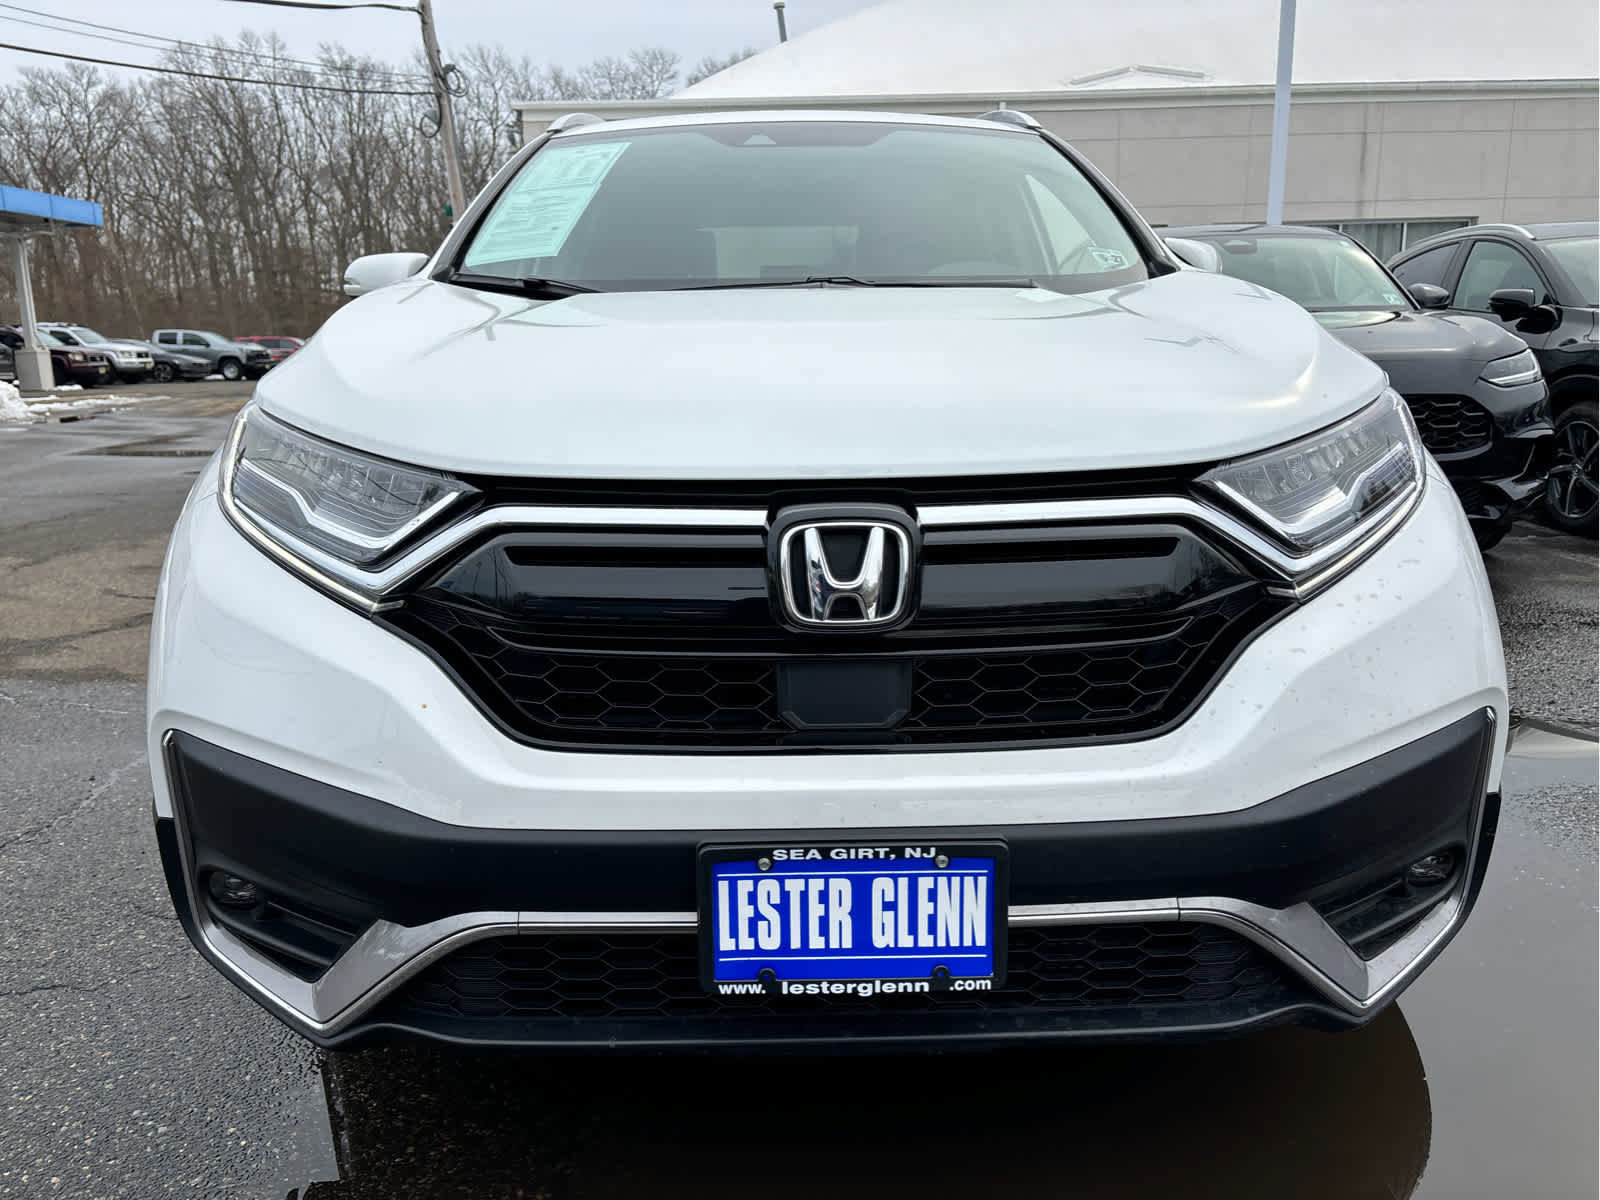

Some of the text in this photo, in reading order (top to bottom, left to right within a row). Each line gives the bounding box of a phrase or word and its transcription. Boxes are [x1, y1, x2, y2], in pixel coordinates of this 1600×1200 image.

[772, 847, 937, 861] SEA GIRT, NJ
[717, 876, 988, 952] LESTER GLENN
[718, 977, 992, 997] www. lesterglenn .com
